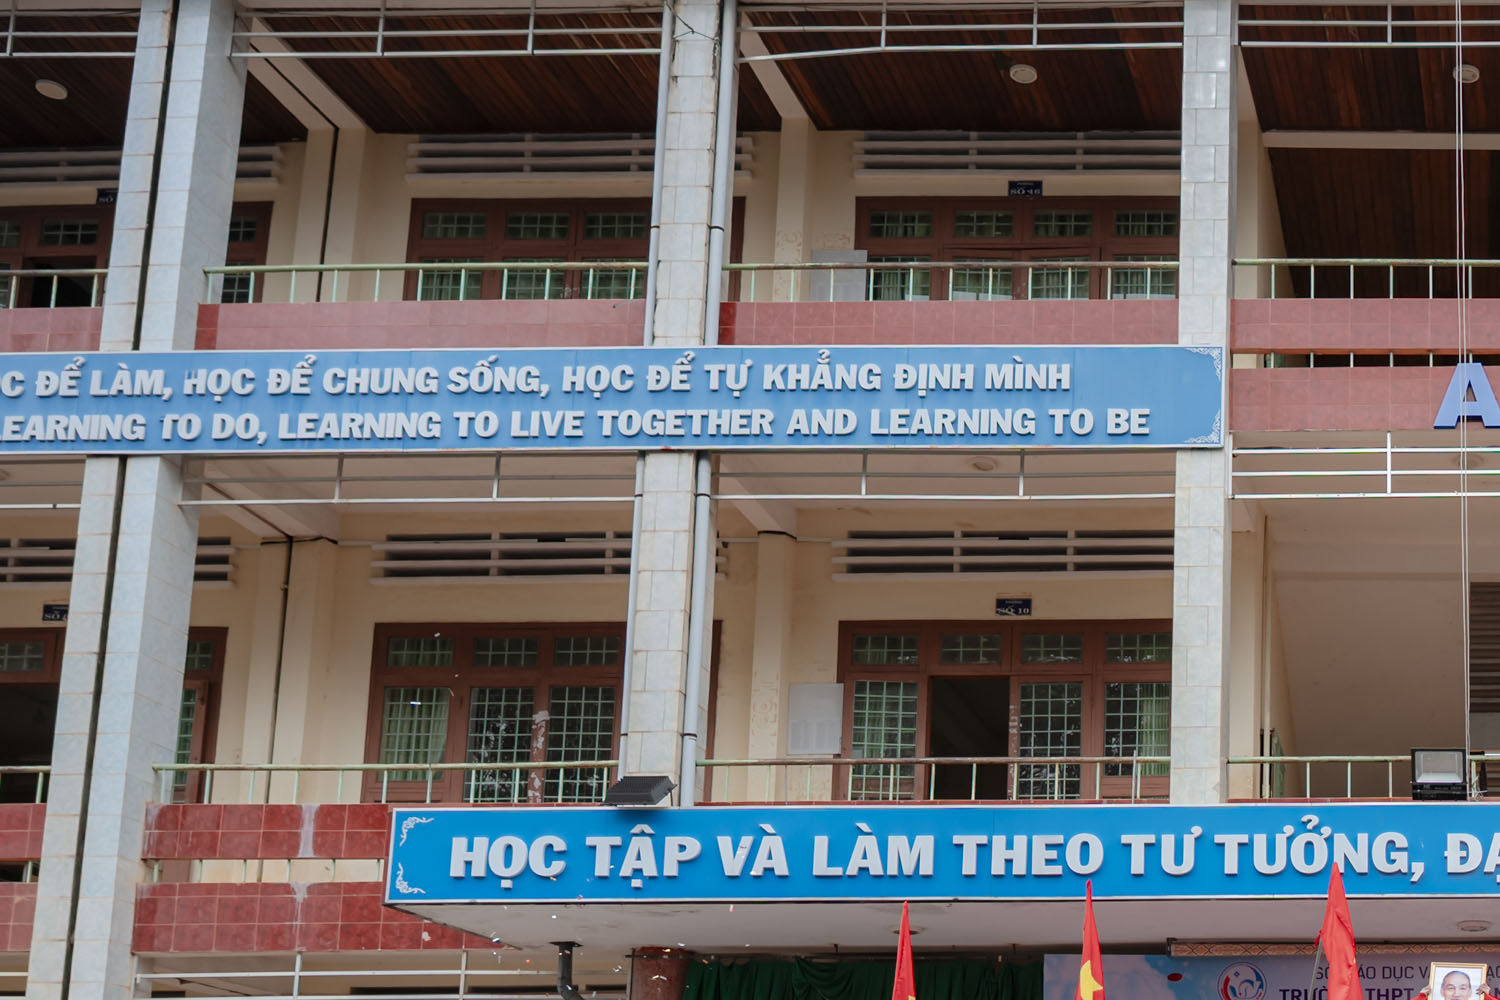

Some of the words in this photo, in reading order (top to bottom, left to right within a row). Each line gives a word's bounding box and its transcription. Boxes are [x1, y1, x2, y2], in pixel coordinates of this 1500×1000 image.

[35, 356, 86, 397] ĐỂ
[90, 362, 173, 400] LÀM,
[184, 368, 255, 403] HỌC
[266, 354, 318, 395] ĐỂ
[323, 366, 439, 395] CHUNG
[447, 354, 549, 398] SỐNG,
[562, 364, 634, 399] HỌC
[646, 351, 695, 391] ĐỂ
[704, 360, 753, 397] TỰ
[894, 364, 974, 397] ĐỊNH
[985, 356, 1071, 390] MÌNH
[161, 415, 201, 441] TO
[212, 414, 267, 445] DO,
[278, 413, 441, 440] LEARNING
[454, 412, 499, 438] TO
[511, 411, 584, 438] LIVE
[600, 409, 773, 437] TOGETHER
[787, 409, 857, 436] AND
[871, 409, 1036, 436] LEARNING
[1049, 409, 1094, 435] TO
[1107, 409, 1150, 435] BE
[450, 835, 568, 889] HỌC
[586, 824, 701, 889] TẬP
[718, 824, 790, 878] VÀ
[812, 822, 935, 878] LÀM
[952, 834, 1104, 876] THEO
[1122, 826, 1201, 875] TƯ
[1214, 815, 1425, 882] TƯỞNG,
[1382, 966, 1414, 981] DỤC
